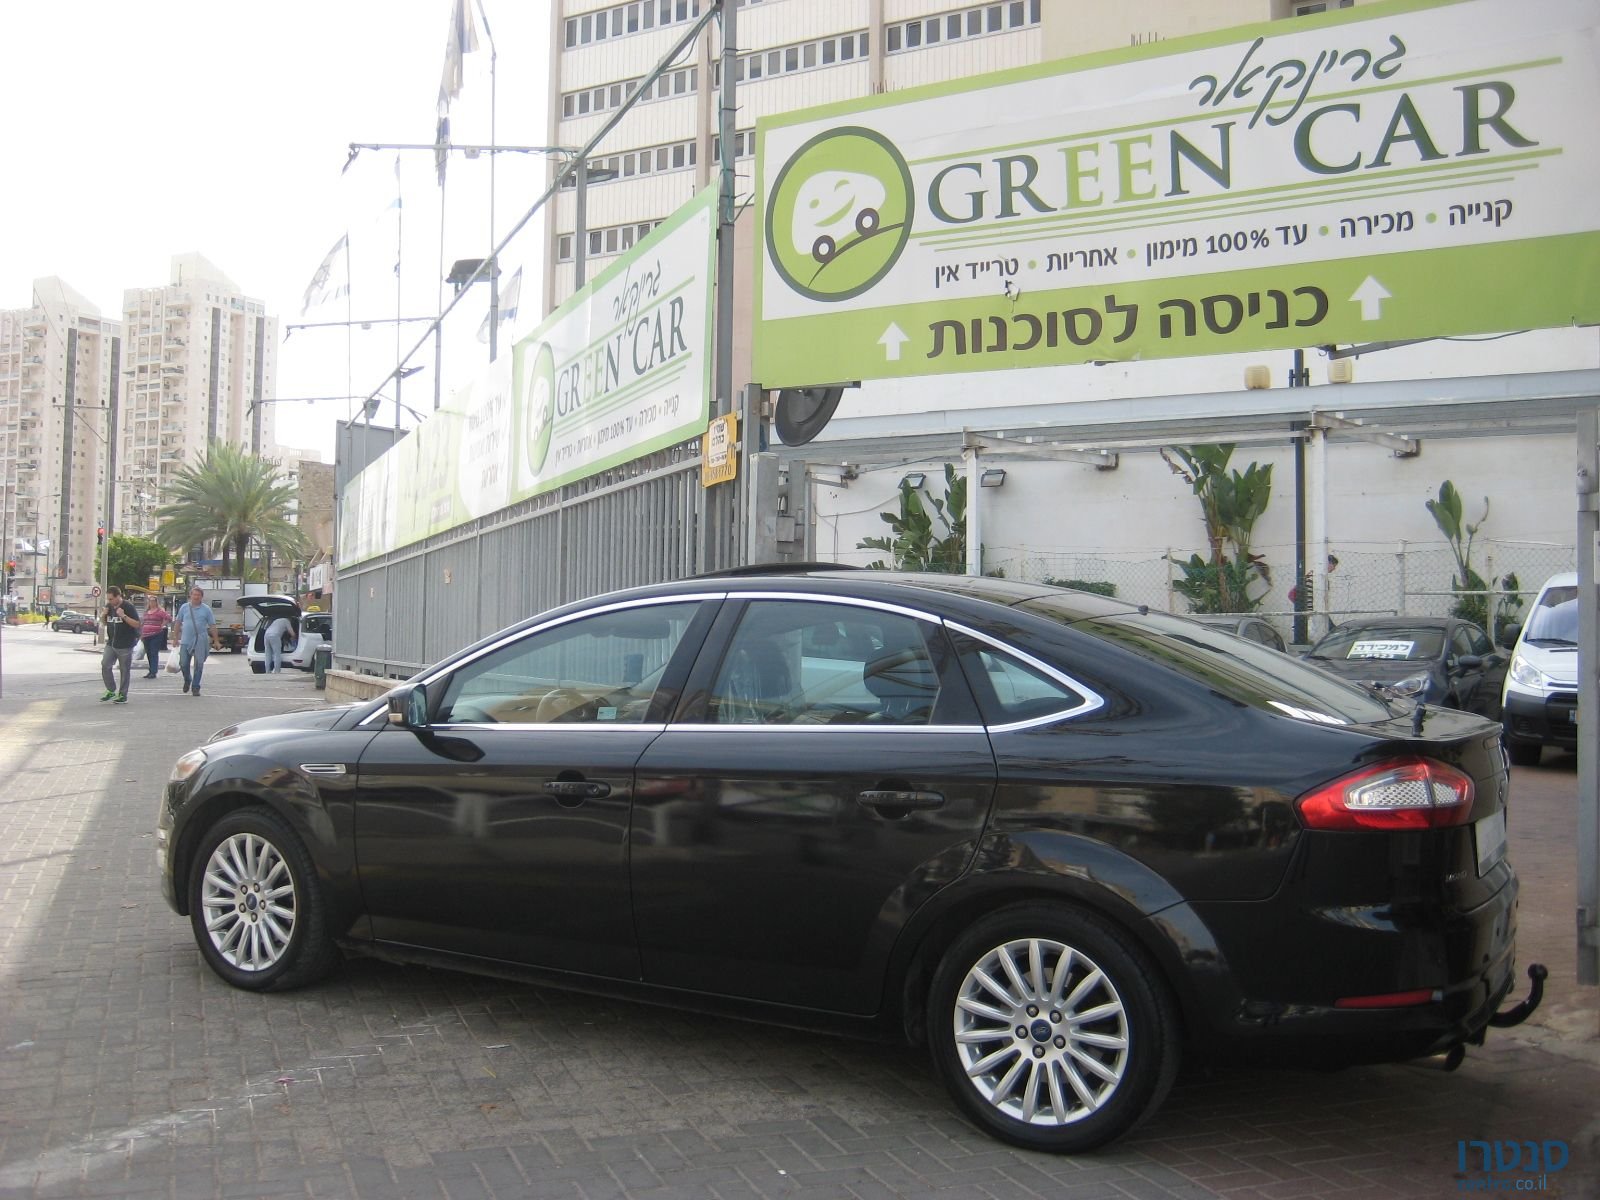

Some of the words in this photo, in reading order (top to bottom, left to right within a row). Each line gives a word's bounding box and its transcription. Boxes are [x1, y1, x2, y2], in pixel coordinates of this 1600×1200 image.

[1188, 34, 1406, 129] גרינקאר
[927, 121, 1236, 224] GREEN
[1293, 80, 1540, 175] CAR
[1339, 210, 1414, 238] מכירה
[1448, 198, 1513, 227] קנייה
[1206, 228, 1270, 254] 100%
[1276, 222, 1308, 246] עד
[1046, 246, 1118, 273] אחריות
[1146, 234, 1198, 268] מימון
[935, 264, 960, 289] אין
[965, 257, 1020, 281] טרייד
[1159, 285, 1329, 339] כניסה
[926, 294, 1139, 360] לסוכנות
[557, 334, 622, 417] GREEN
[633, 296, 687, 376] CAR
